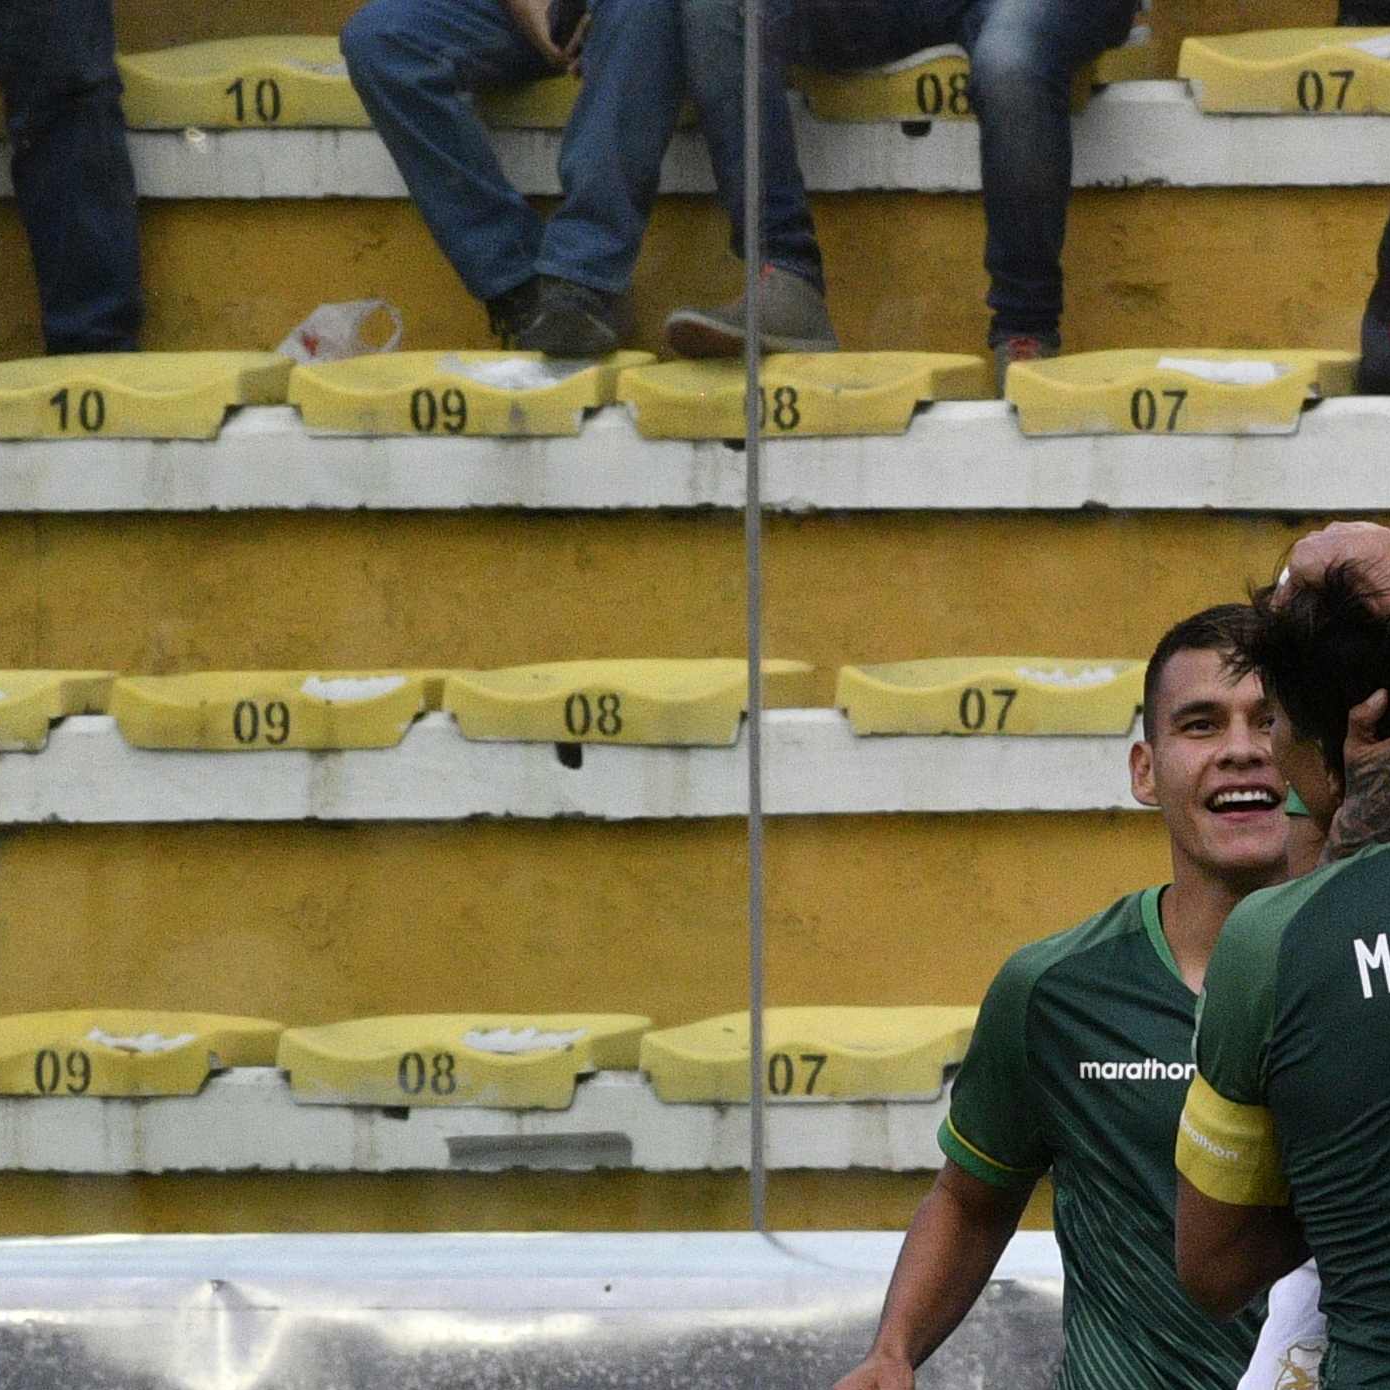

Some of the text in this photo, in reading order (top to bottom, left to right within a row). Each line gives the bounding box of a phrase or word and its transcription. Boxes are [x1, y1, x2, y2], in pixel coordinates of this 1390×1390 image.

[226, 78, 281, 121] 10
[916, 74, 971, 115] 08
[1297, 70, 1354, 111] 07
[50, 388, 106, 432] 10
[410, 389, 468, 434] 09
[1130, 389, 1188, 431] 07
[233, 701, 292, 745] 09
[565, 694, 623, 736] 08
[959, 688, 1018, 731] 07
[33, 1050, 92, 1095] 09
[398, 1052, 456, 1096] 08
[767, 1053, 827, 1096] 07
[1079, 1058, 1198, 1080] marathon
